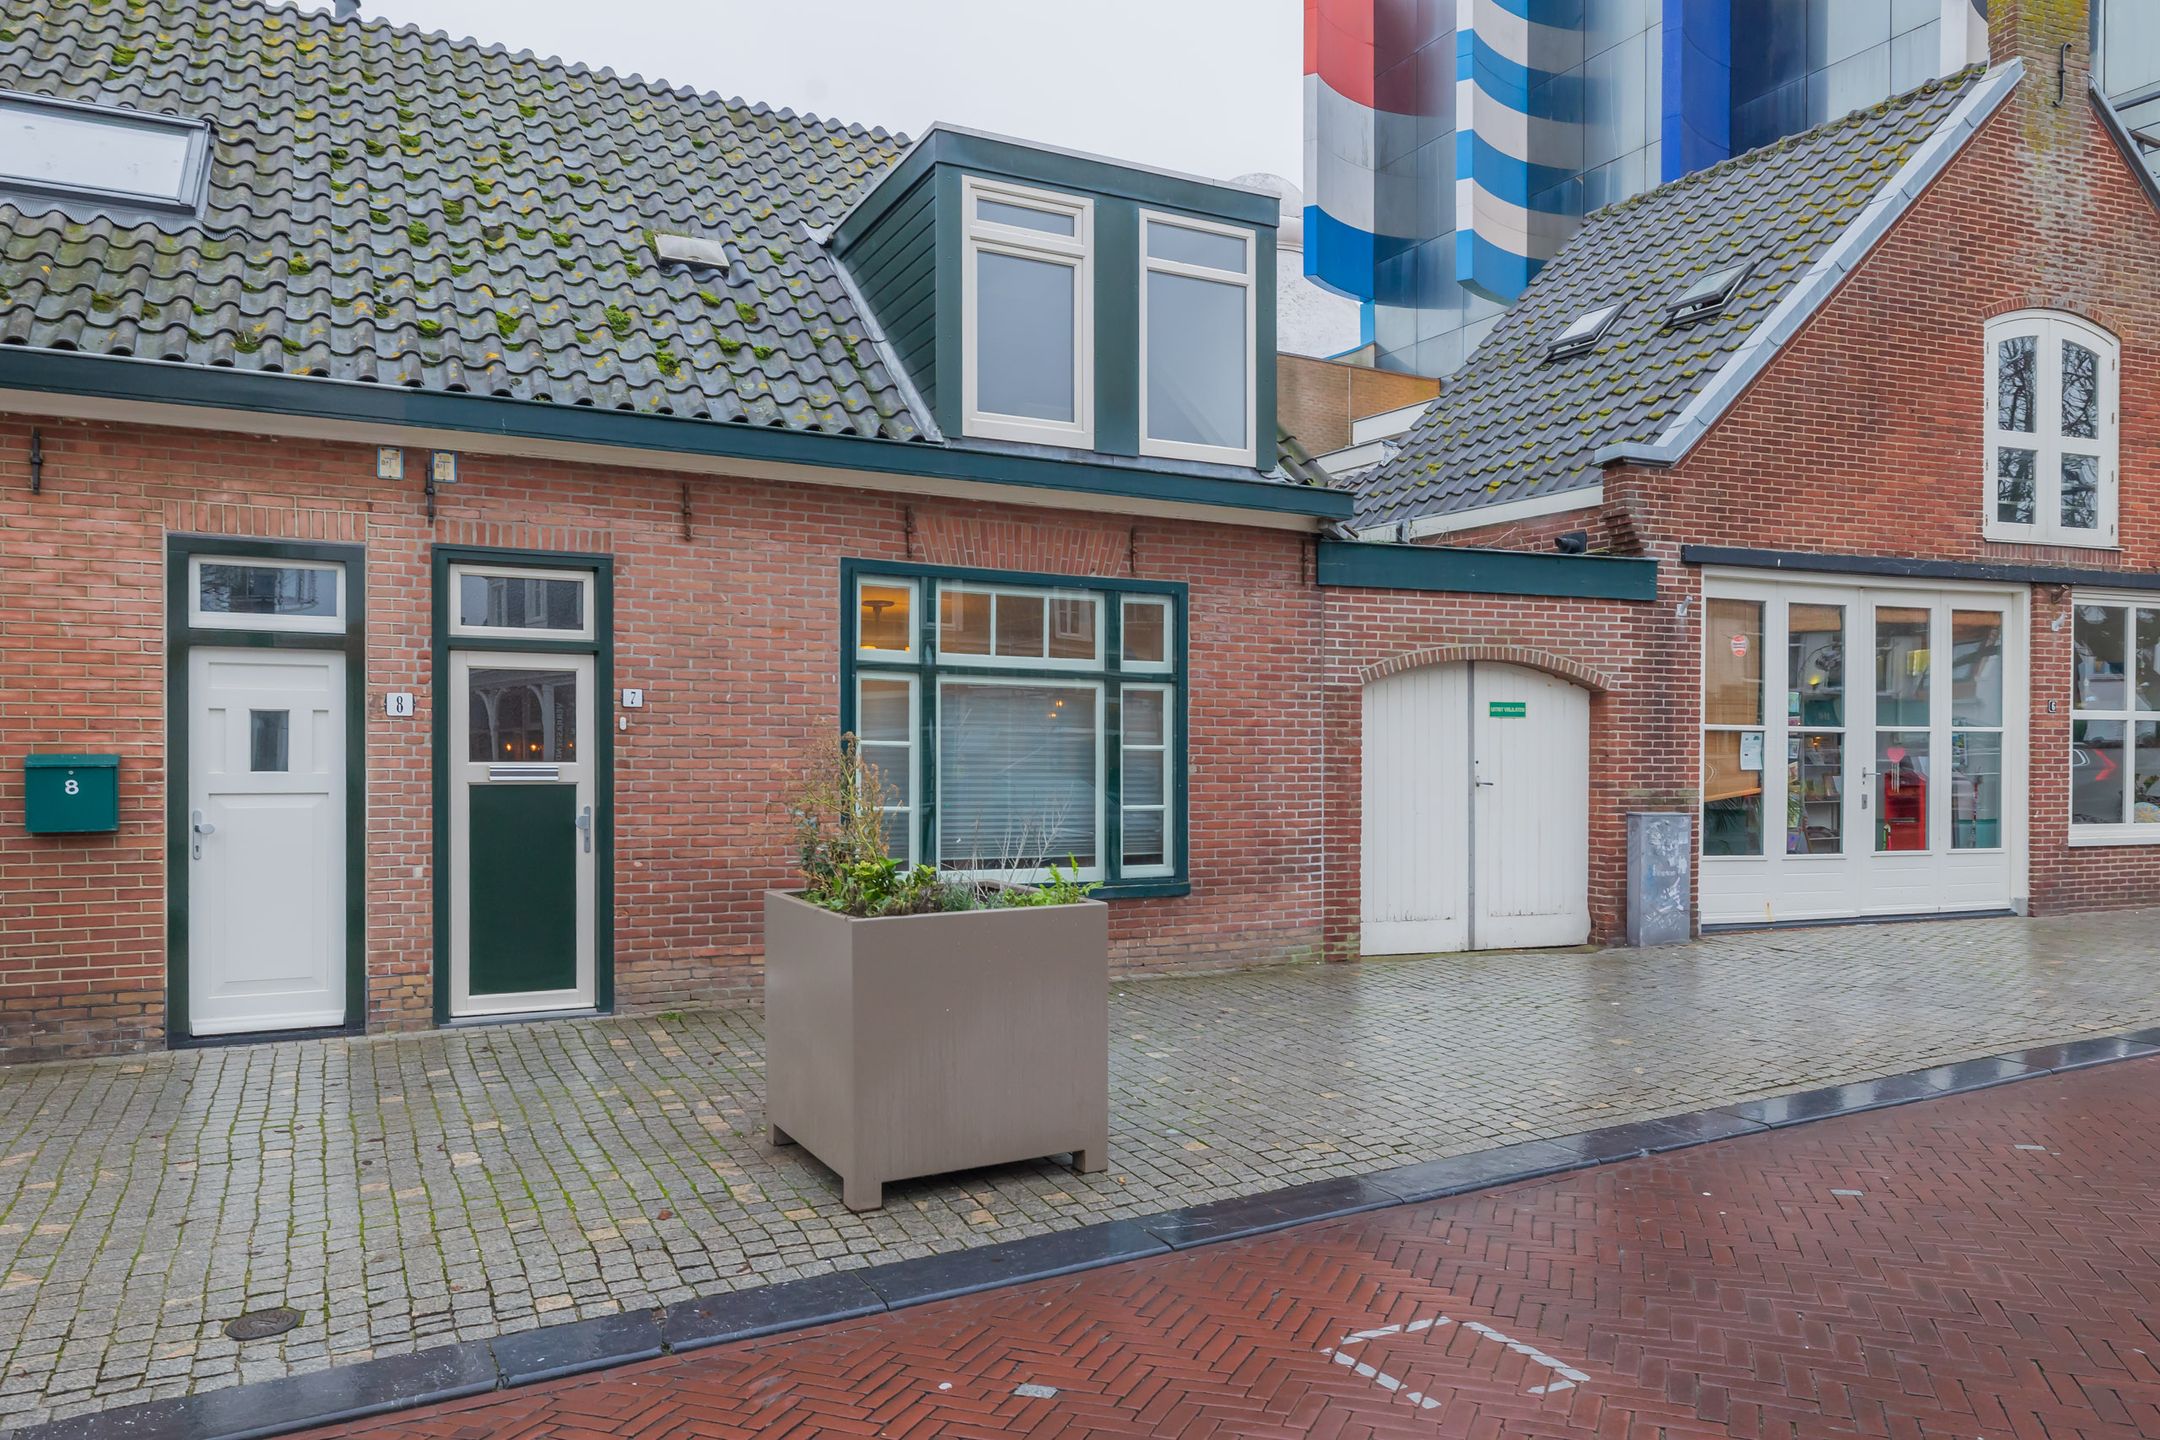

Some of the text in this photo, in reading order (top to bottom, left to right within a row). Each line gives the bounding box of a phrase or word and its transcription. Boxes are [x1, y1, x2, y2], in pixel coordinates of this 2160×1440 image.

[396, 696, 404, 713] 8
[630, 691, 636, 705] 7
[65, 779, 79, 795] 8
